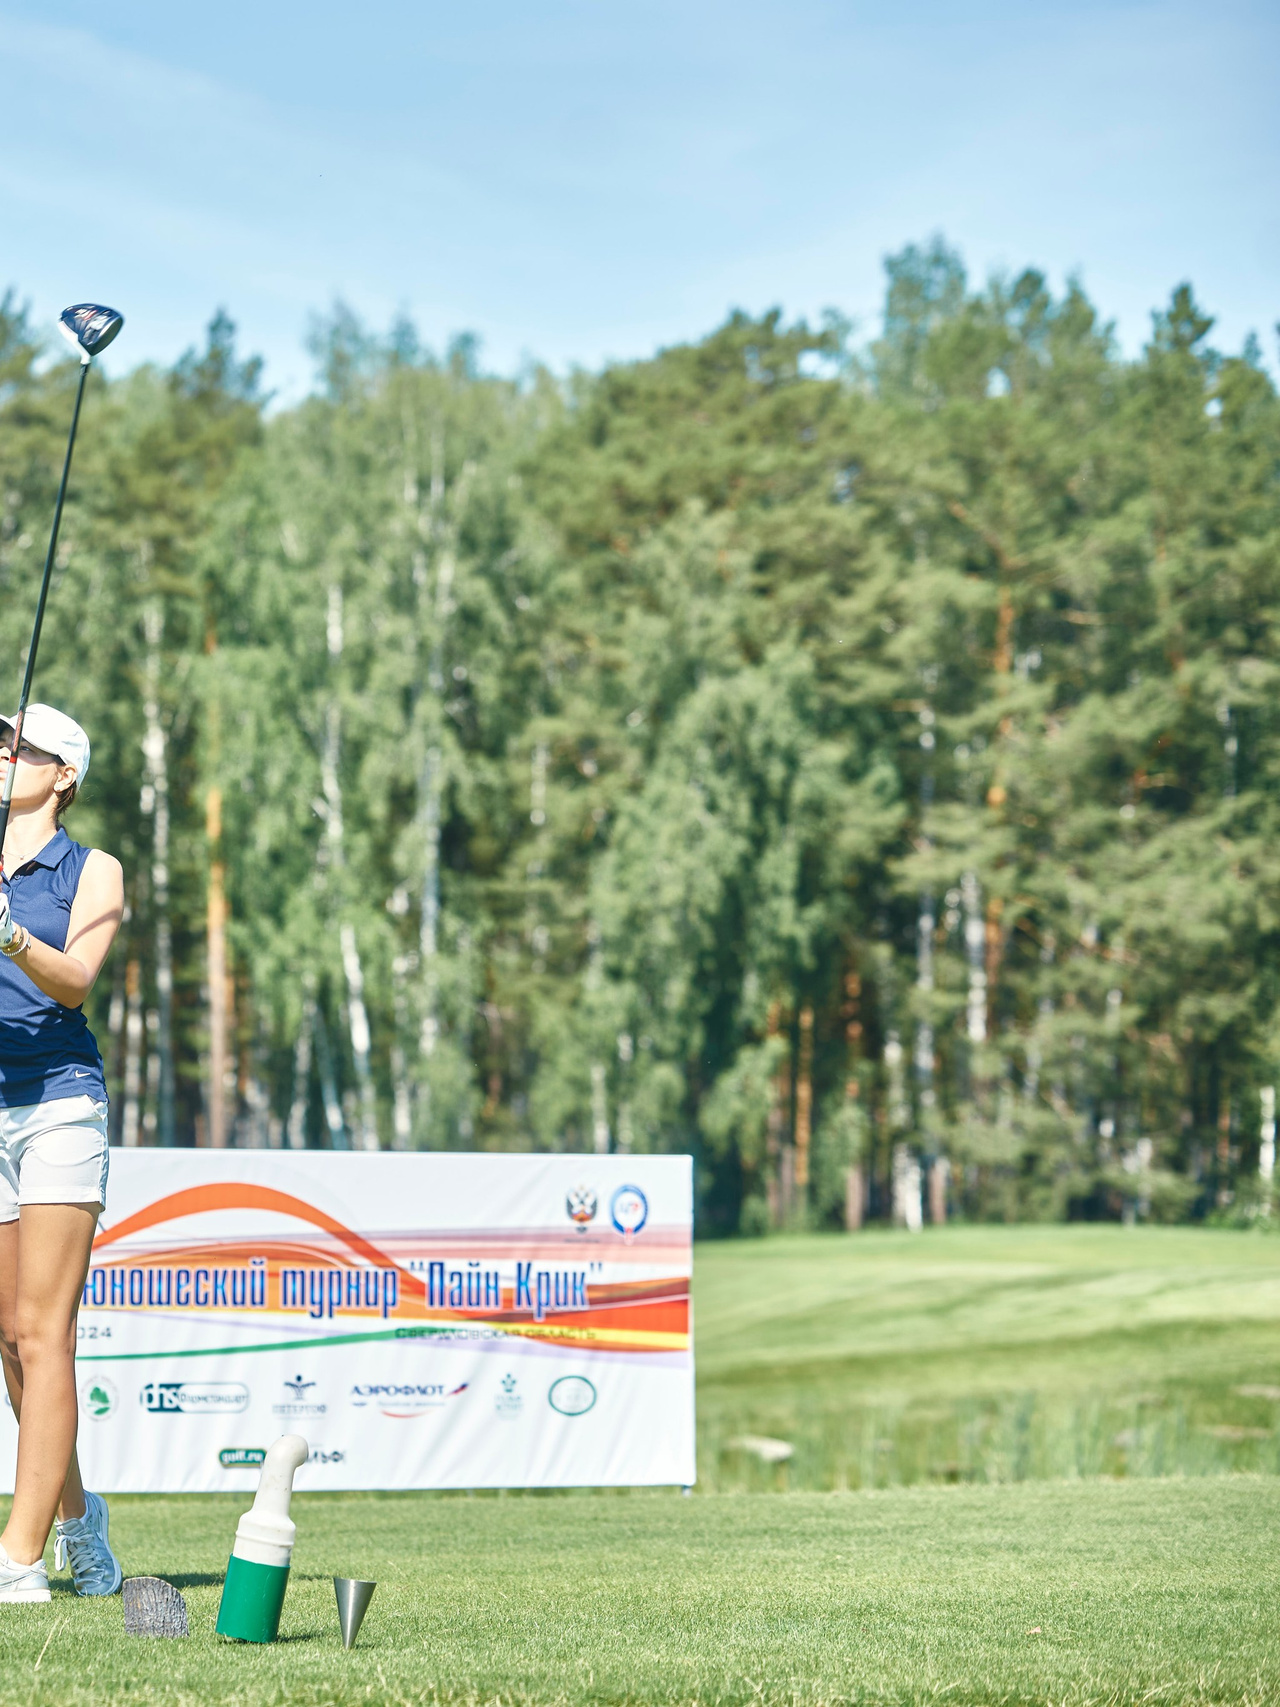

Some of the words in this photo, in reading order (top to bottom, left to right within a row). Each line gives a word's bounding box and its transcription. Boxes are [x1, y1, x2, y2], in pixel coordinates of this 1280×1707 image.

[282, 1268, 398, 1319] турнир
[77, 1326, 112, 1338] 024
[351, 1384, 445, 1396] АЭРОФЛОТ
